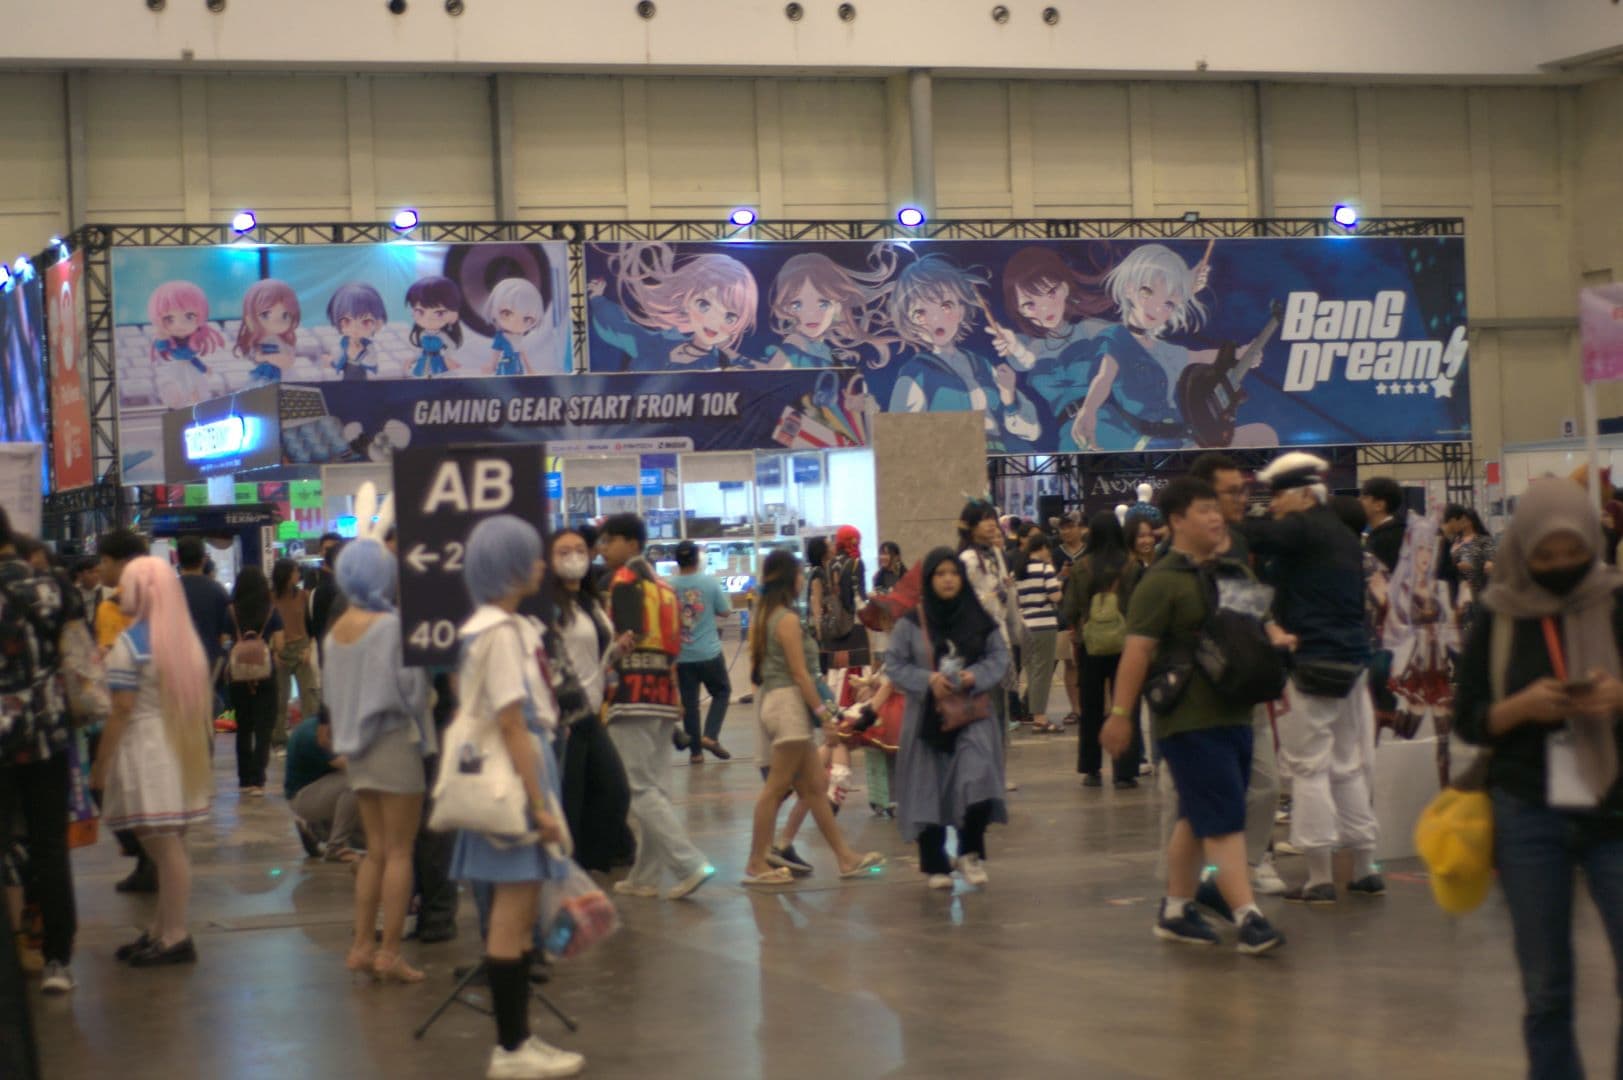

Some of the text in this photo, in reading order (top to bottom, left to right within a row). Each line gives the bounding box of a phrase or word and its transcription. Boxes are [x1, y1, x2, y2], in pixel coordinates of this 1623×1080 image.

[1280, 290, 1406, 341] BanG
[413, 391, 740, 424] GAMING GEAR START FROM 10K
[423, 459, 514, 514] AB
